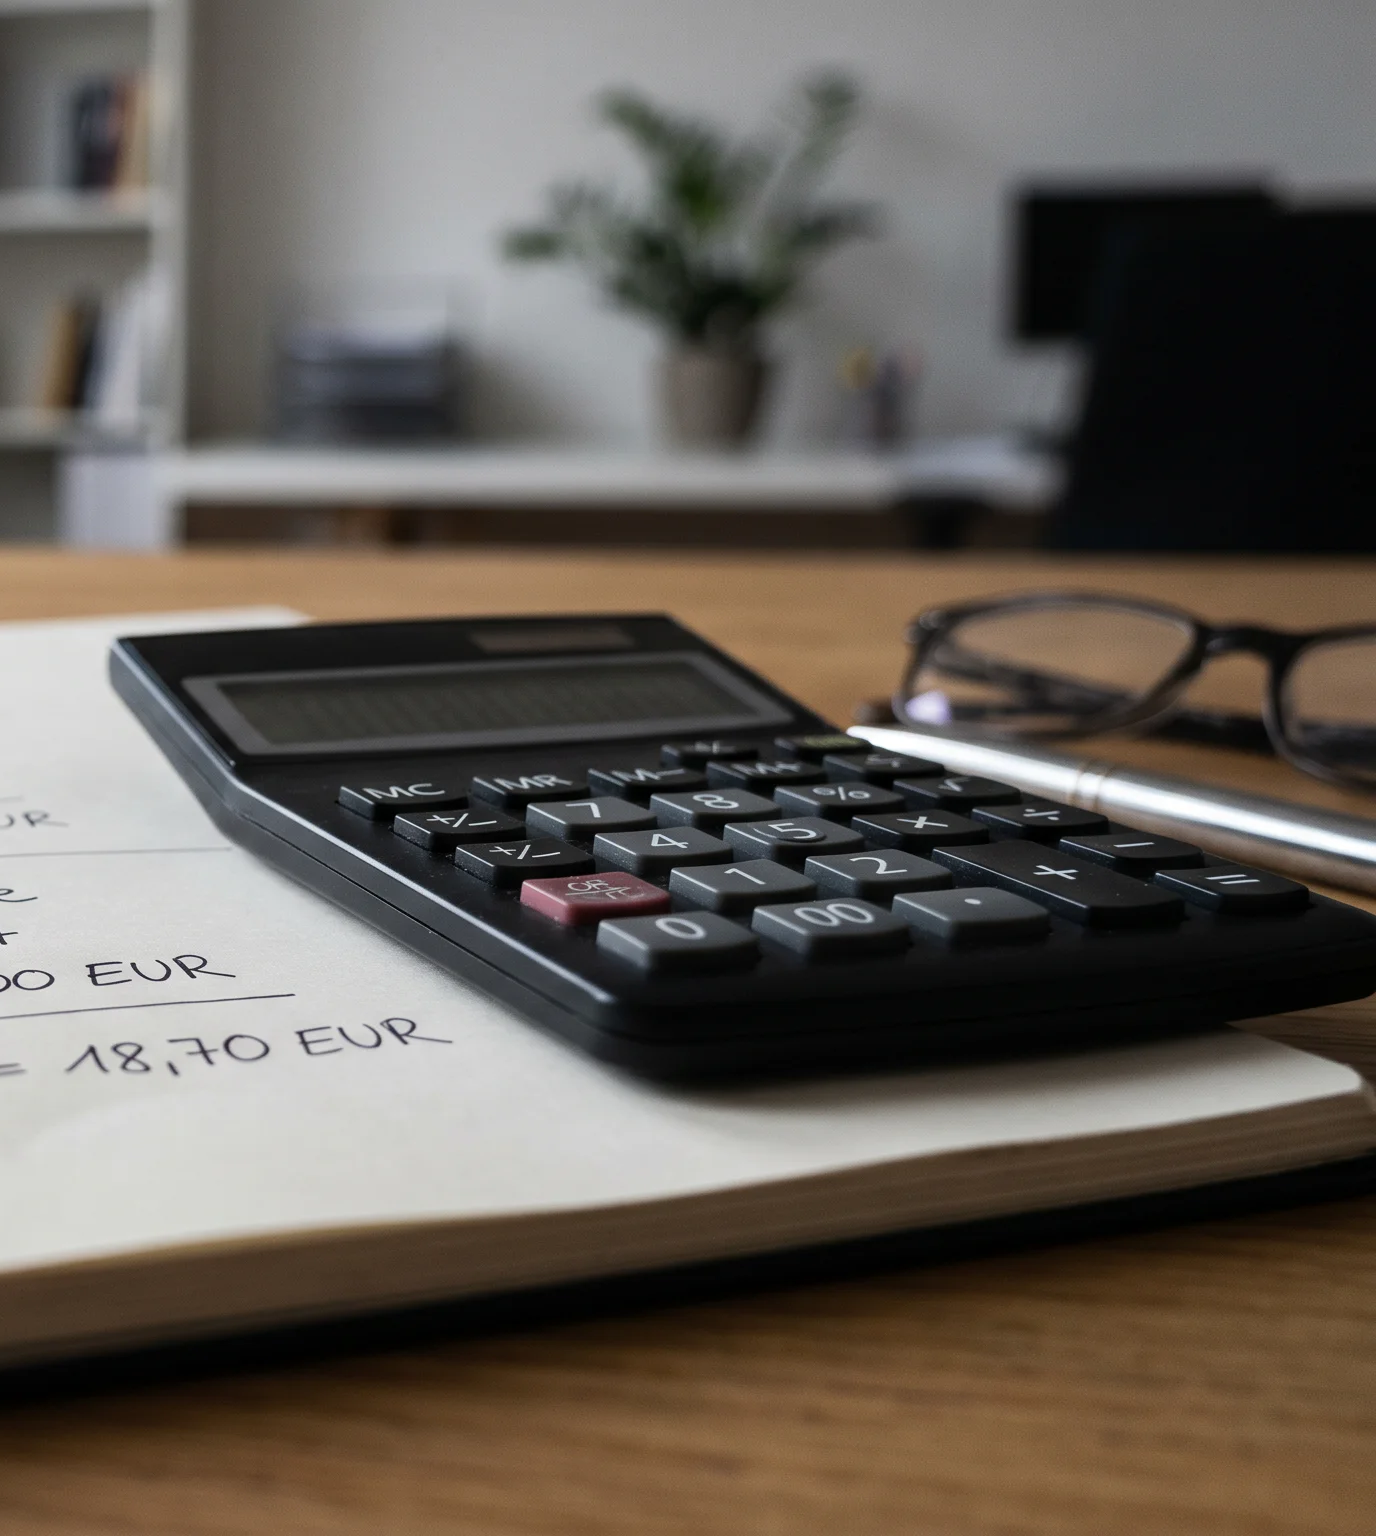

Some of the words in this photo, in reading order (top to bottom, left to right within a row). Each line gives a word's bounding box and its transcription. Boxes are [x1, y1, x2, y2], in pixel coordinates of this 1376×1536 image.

[363, 783, 445, 799] MC
[494, 774, 573, 791] MR
[692, 793, 740, 810] 8
[813, 786, 871, 801] %
[565, 802, 601, 818] 7
[767, 822, 817, 840] 5
[651, 833, 689, 850] 4
[849, 857, 908, 876] 2
[1034, 864, 1080, 881] +
[724, 867, 767, 886] 1
[1204, 873, 1260, 885] =
[793, 903, 875, 927] 00
[655, 917, 707, 940] 0
[86, 954, 236, 986] EUR
[64, 1033, 270, 1076] 18,70
[294, 1016, 453, 1056] EUR
